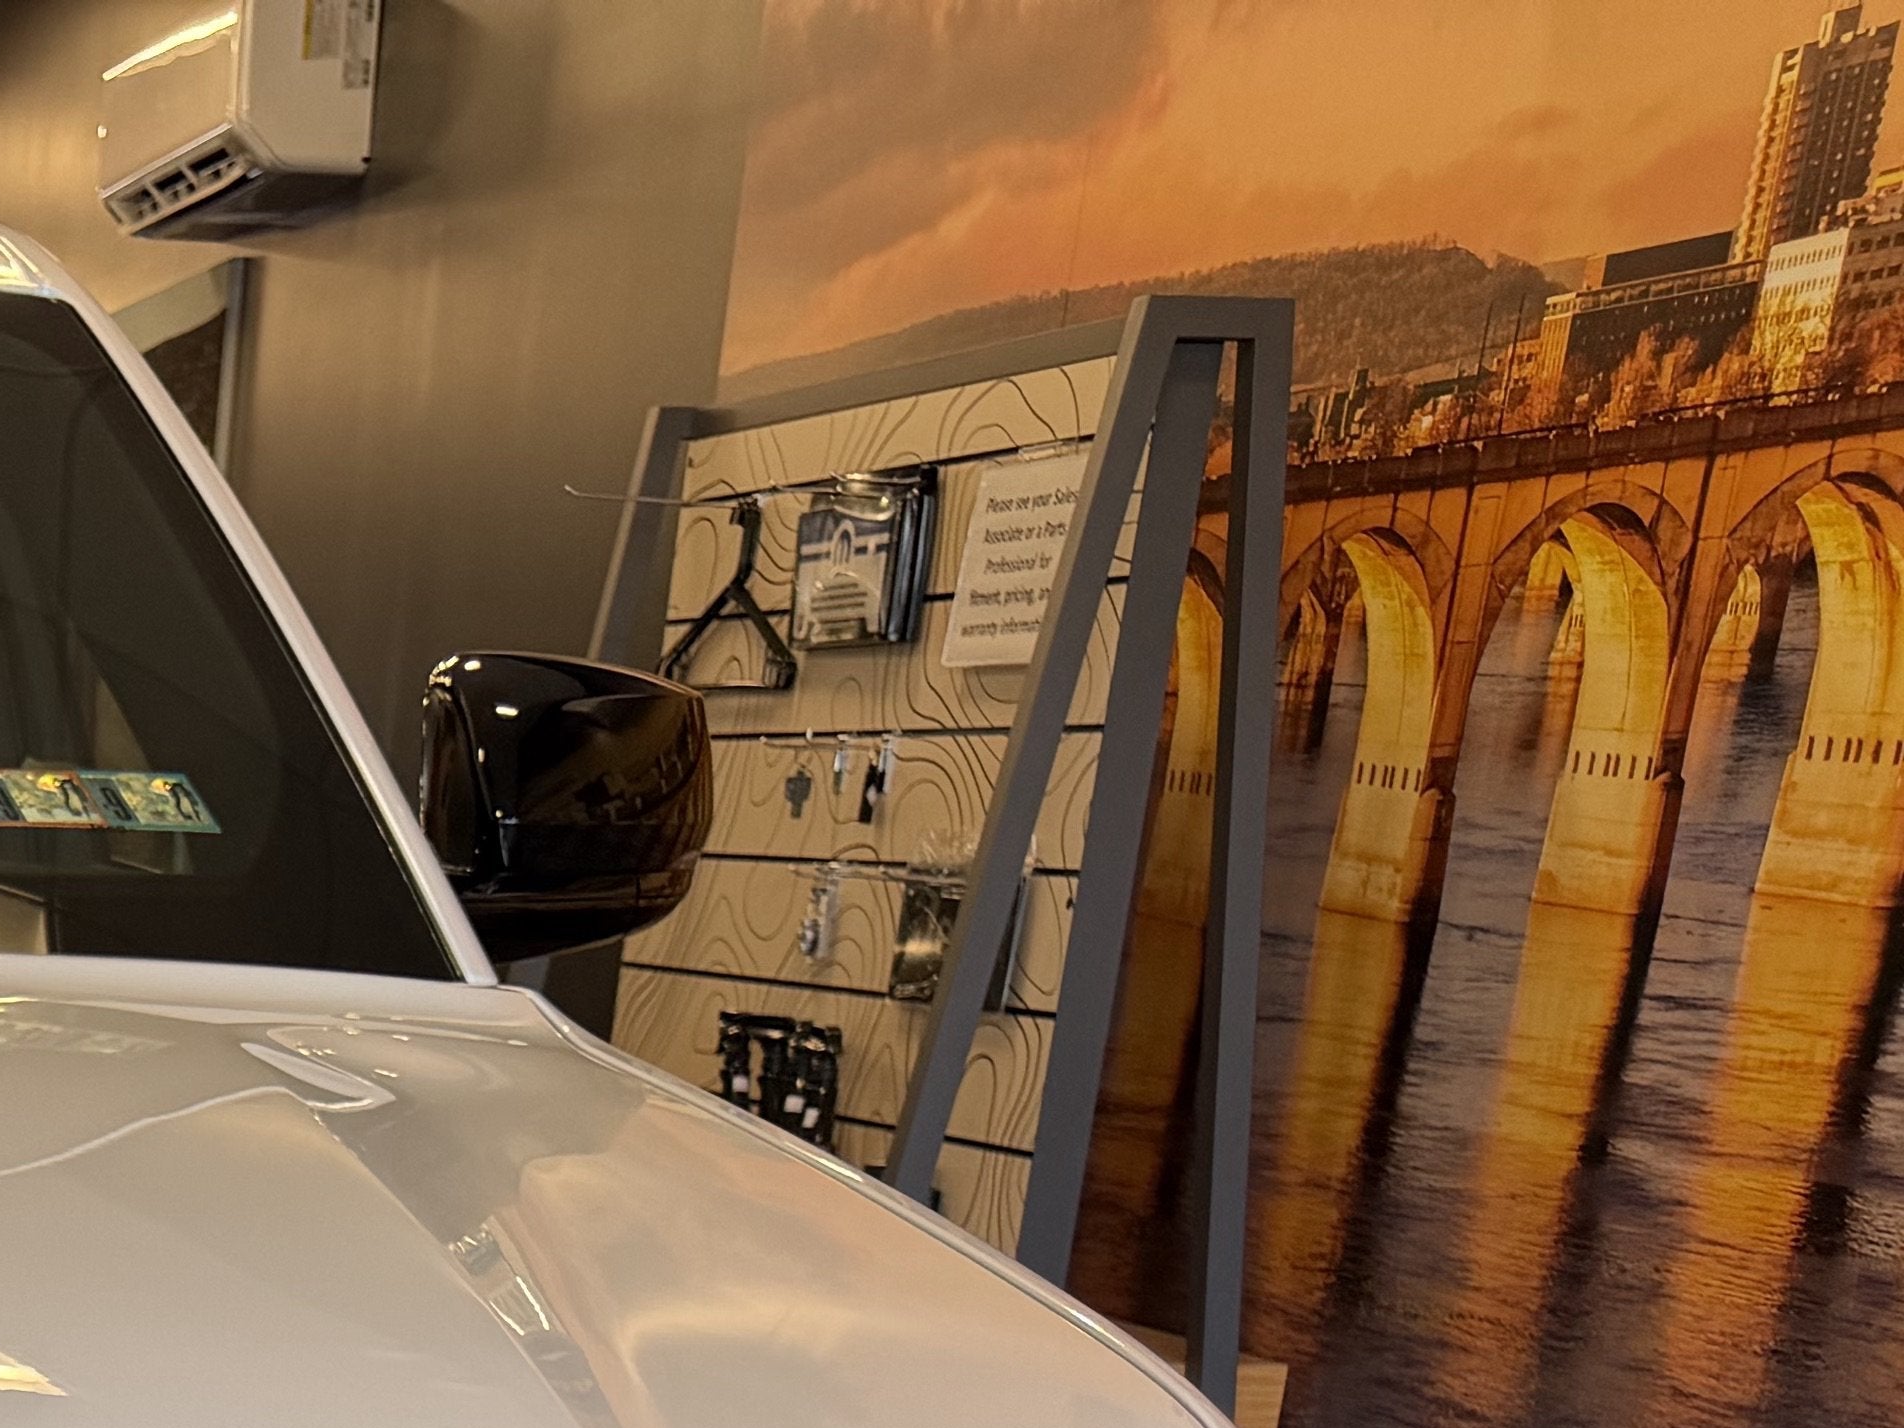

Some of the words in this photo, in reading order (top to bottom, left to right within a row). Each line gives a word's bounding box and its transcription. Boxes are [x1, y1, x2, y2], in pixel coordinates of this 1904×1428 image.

[985, 495, 1013, 513] Please
[1014, 496, 1031, 511] see
[1031, 493, 1053, 513] your
[983, 524, 1024, 545] Associate
[984, 552, 1039, 575] Professional
